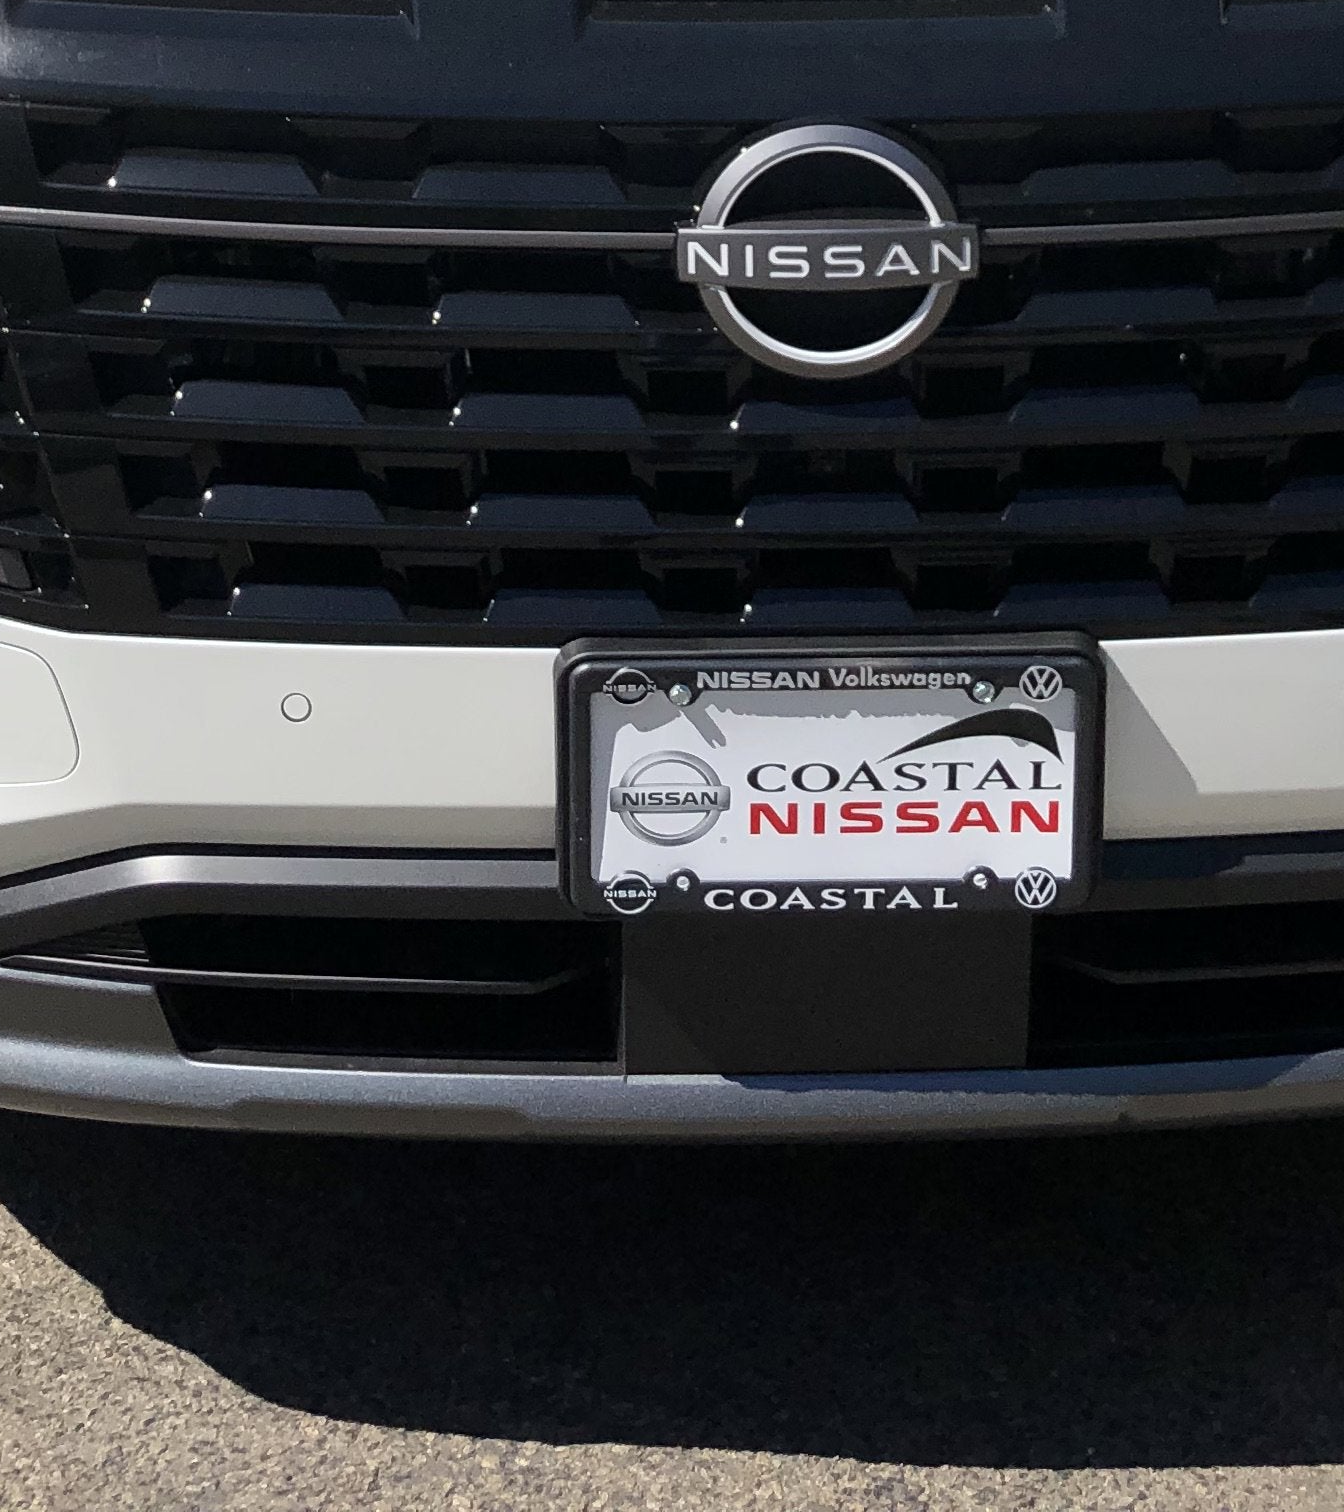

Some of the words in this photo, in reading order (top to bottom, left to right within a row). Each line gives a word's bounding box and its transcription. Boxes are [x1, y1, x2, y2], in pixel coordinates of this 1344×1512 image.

[686, 237, 972, 278] NISSAN
[602, 683, 657, 694] NISSAN
[696, 671, 820, 689] NISSAN
[828, 666, 972, 689] Volkswagen
[746, 758, 1063, 793] COASTAL
[621, 791, 719, 807] NISSAN
[749, 800, 1060, 835] NISSAN
[603, 889, 657, 899] NISSAN
[703, 885, 959, 911] COASTAL
